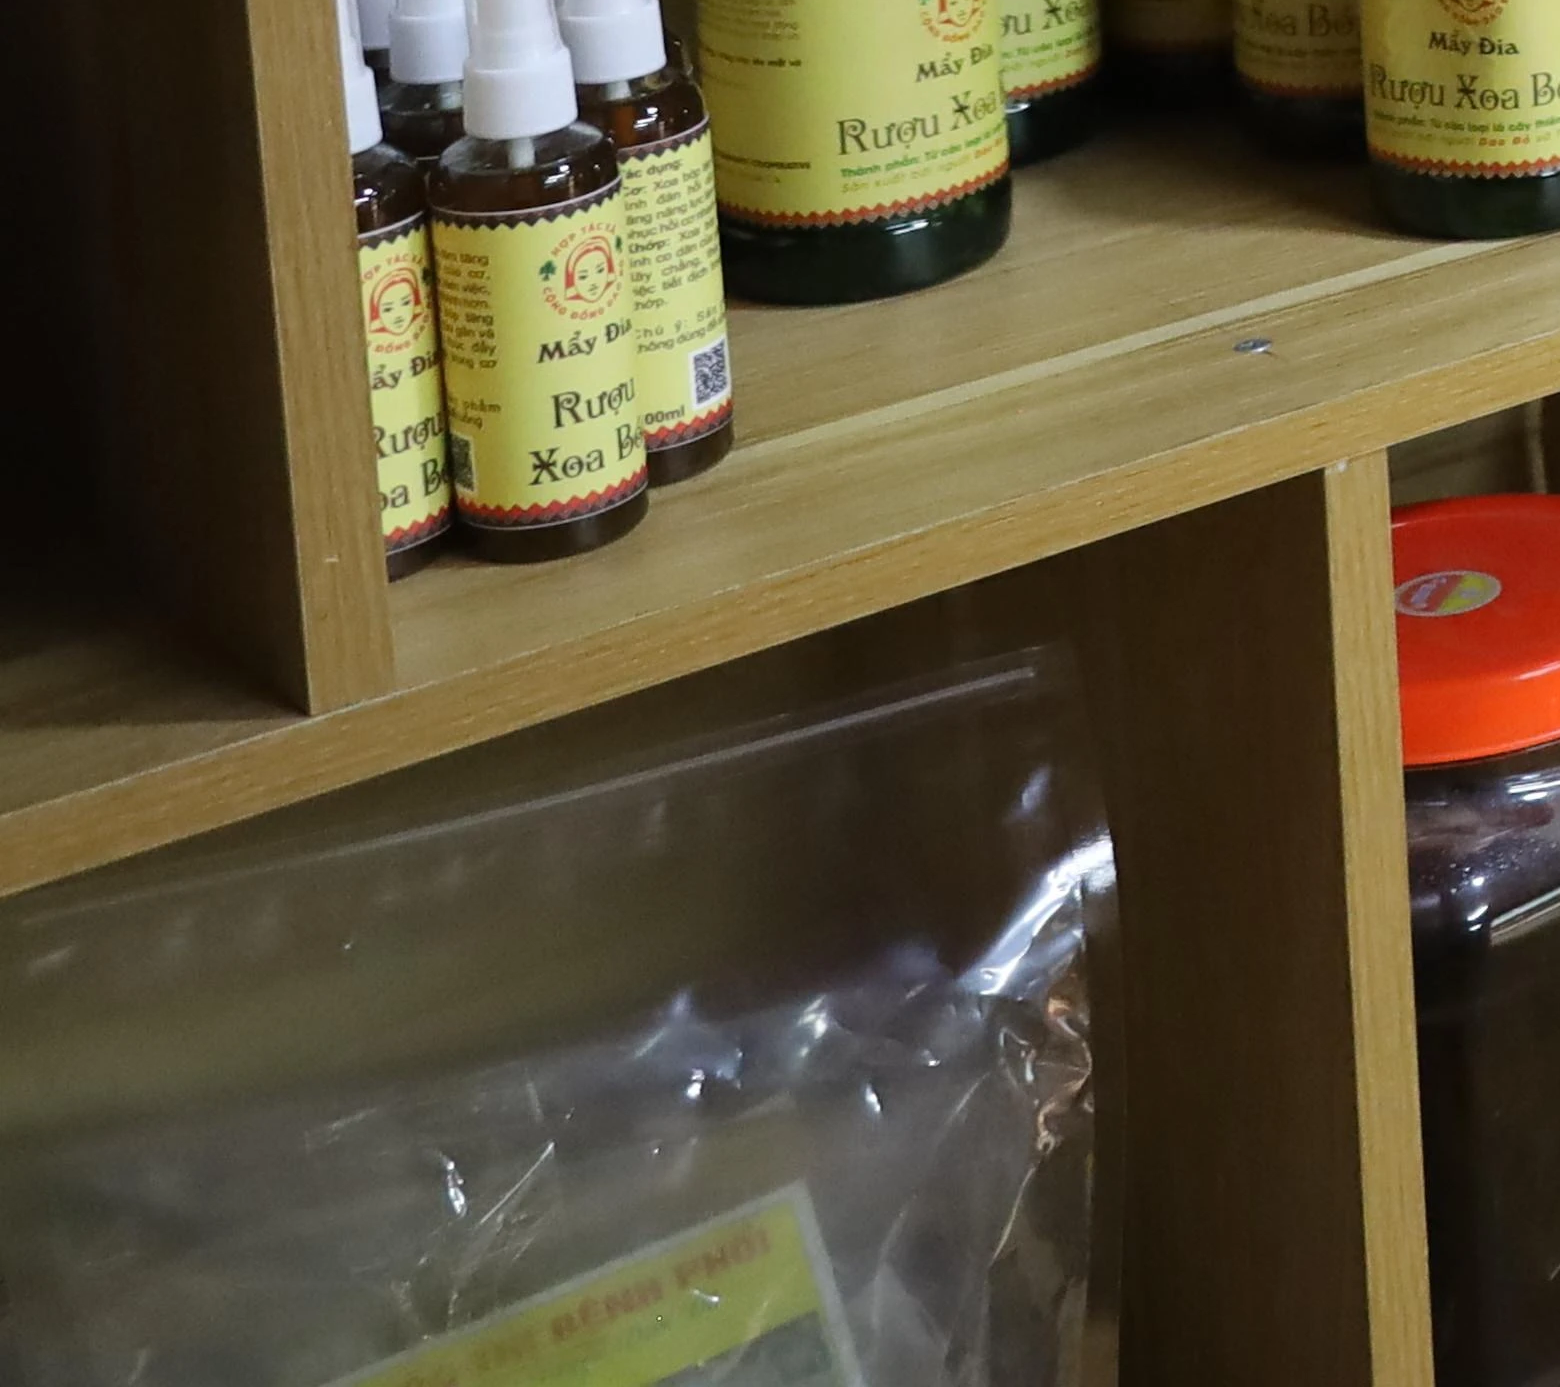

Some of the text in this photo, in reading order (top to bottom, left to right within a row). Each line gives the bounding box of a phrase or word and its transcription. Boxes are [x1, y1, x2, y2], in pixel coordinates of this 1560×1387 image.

[1428, 28, 1521, 56] Mẩy Đia
[915, 51, 964, 83] Mẩy
[1369, 62, 1445, 111] Rượu
[1455, 73, 1521, 111] Xoa
[836, 90, 1001, 157] Rượu Xoa
[624, 168, 643, 181] ác
[634, 296, 670, 312] hớp.
[535, 326, 598, 366] Mẩy
[636, 337, 676, 355] hông
[371, 364, 403, 391] ẩy
[550, 377, 636, 430] Rượu
[643, 404, 687, 427] 00ml
[527, 420, 646, 487] Xoa Bó
